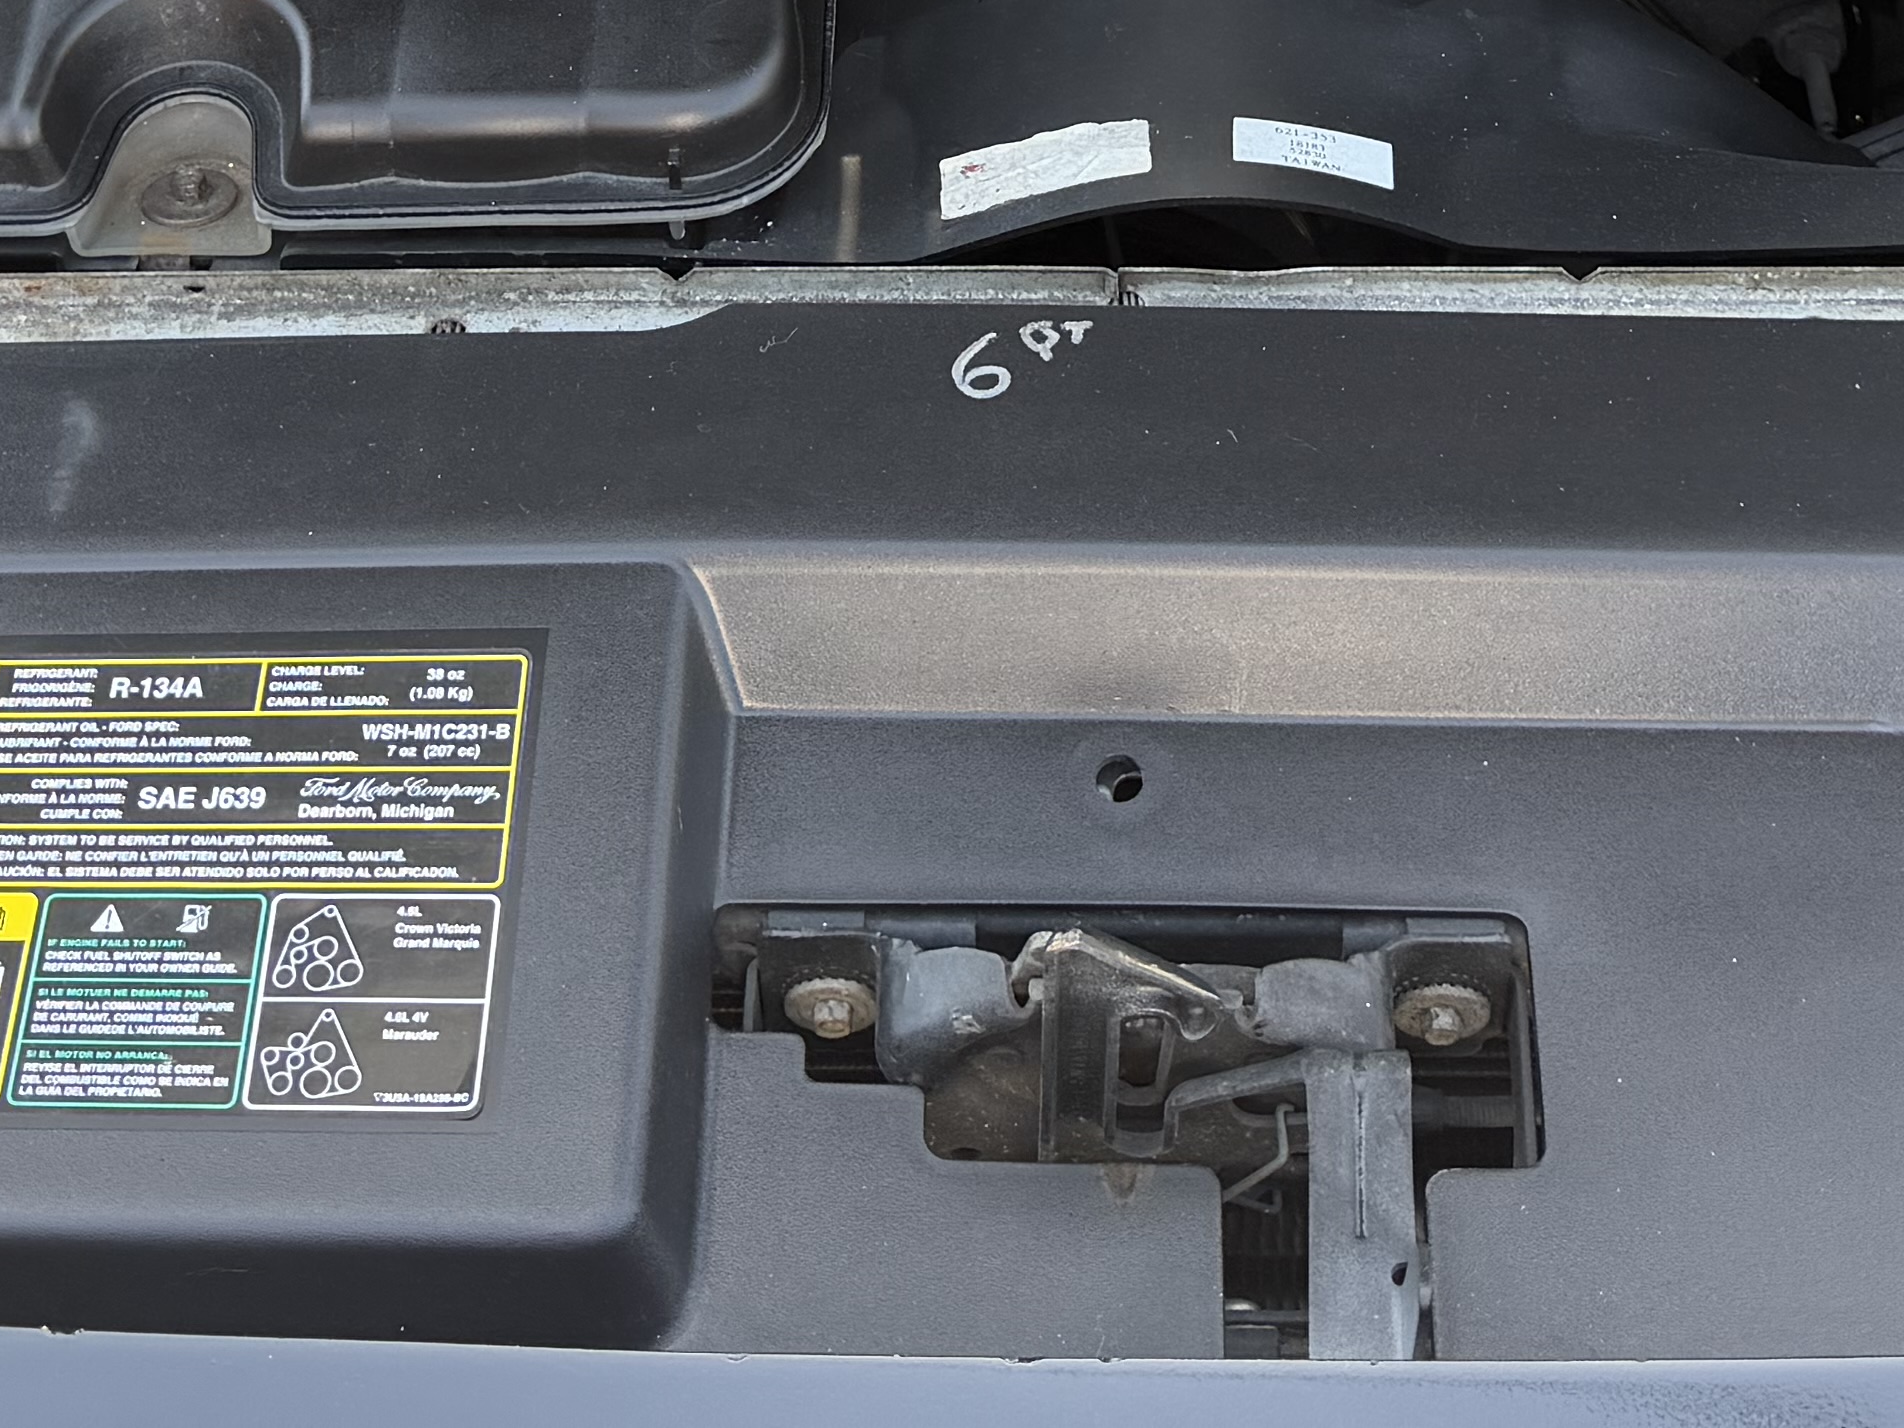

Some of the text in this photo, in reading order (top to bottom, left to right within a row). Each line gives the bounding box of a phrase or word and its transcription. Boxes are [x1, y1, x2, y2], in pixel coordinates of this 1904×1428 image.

[1282, 155, 1341, 172] TAIWAN
[951, 331, 1013, 400] 6
[14, 668, 98, 678] REFRIGERANT:
[272, 666, 365, 676] CHARGE LEVEL:
[426, 669, 465, 680] 38 oz
[109, 676, 204, 699] R-134A
[269, 682, 323, 691] CHARGE:
[409, 687, 474, 702] (1.08 Kg)
[0, 697, 93, 707] REFRIGERANTE:
[266, 696, 389, 707] CARGA DE LLENADO:
[80, 722, 100, 732] OIL
[108, 722, 142, 732] FORD
[144, 722, 180, 732] SPEC:
[362, 724, 510, 740] WSH-M1C231-B
[70, 737, 138, 748] CONFORME
[151, 737, 167, 747] LA
[168, 737, 212, 747] NORME
[214, 737, 251, 747] FORD:
[14, 753, 58, 764] ACEITE
[60, 752, 92, 763] PARA
[94, 752, 193, 763] REFRIGERANTES
[195, 752, 262, 763] CONFORME
[264, 752, 273, 762] A
[275, 752, 320, 762] NORMA
[322, 751, 359, 761] FORD:
[388, 745, 480, 759] 7 oz (207 cc)
[31, 778, 128, 789] COMPLIES WITH:
[300, 777, 346, 798] Ford
[338, 778, 404, 802] Motor
[60, 793, 76, 804] LA
[78, 793, 126, 804] NORME:
[138, 786, 266, 810] SAE J639
[298, 804, 454, 820] Dearborn, Michigan
[28, 834, 77, 846] SYSTEM
[80, 834, 97, 846] TO
[98, 834, 116, 846] BE
[118, 834, 170, 846] SERVICE
[172, 834, 189, 846] BY
[190, 834, 255, 846] QUALIFIED
[256, 835, 334, 846] PERSONNEL.
[46, 867, 63, 877] EL
[65, 867, 118, 877] SISTEMA
[120, 867, 153, 877] DEBE
[155, 867, 180, 877] SER
[182, 866, 244, 878] ATENDIDO
[246, 867, 279, 877] SOLO
[282, 867, 309, 877] POR
[355, 867, 372, 877] AL
[395, 923, 481, 934] Crown Victoria
[60, 939, 99, 948] ENGINE
[100, 939, 129, 947] FAILS
[133, 939, 147, 947] TO
[150, 939, 186, 947] START:
[393, 937, 480, 950] Grand Marquis
[45, 951, 221, 961] CHECK FUEL SHUTOFF SWITCH AS
[42, 963, 118, 973] REFERENCED
[129, 963, 158, 973] YOUR
[160, 963, 199, 973] OWNER
[201, 963, 238, 973] GUIDE.
[412, 1012, 429, 1023] 4V
[382, 1029, 439, 1041] Marauder
